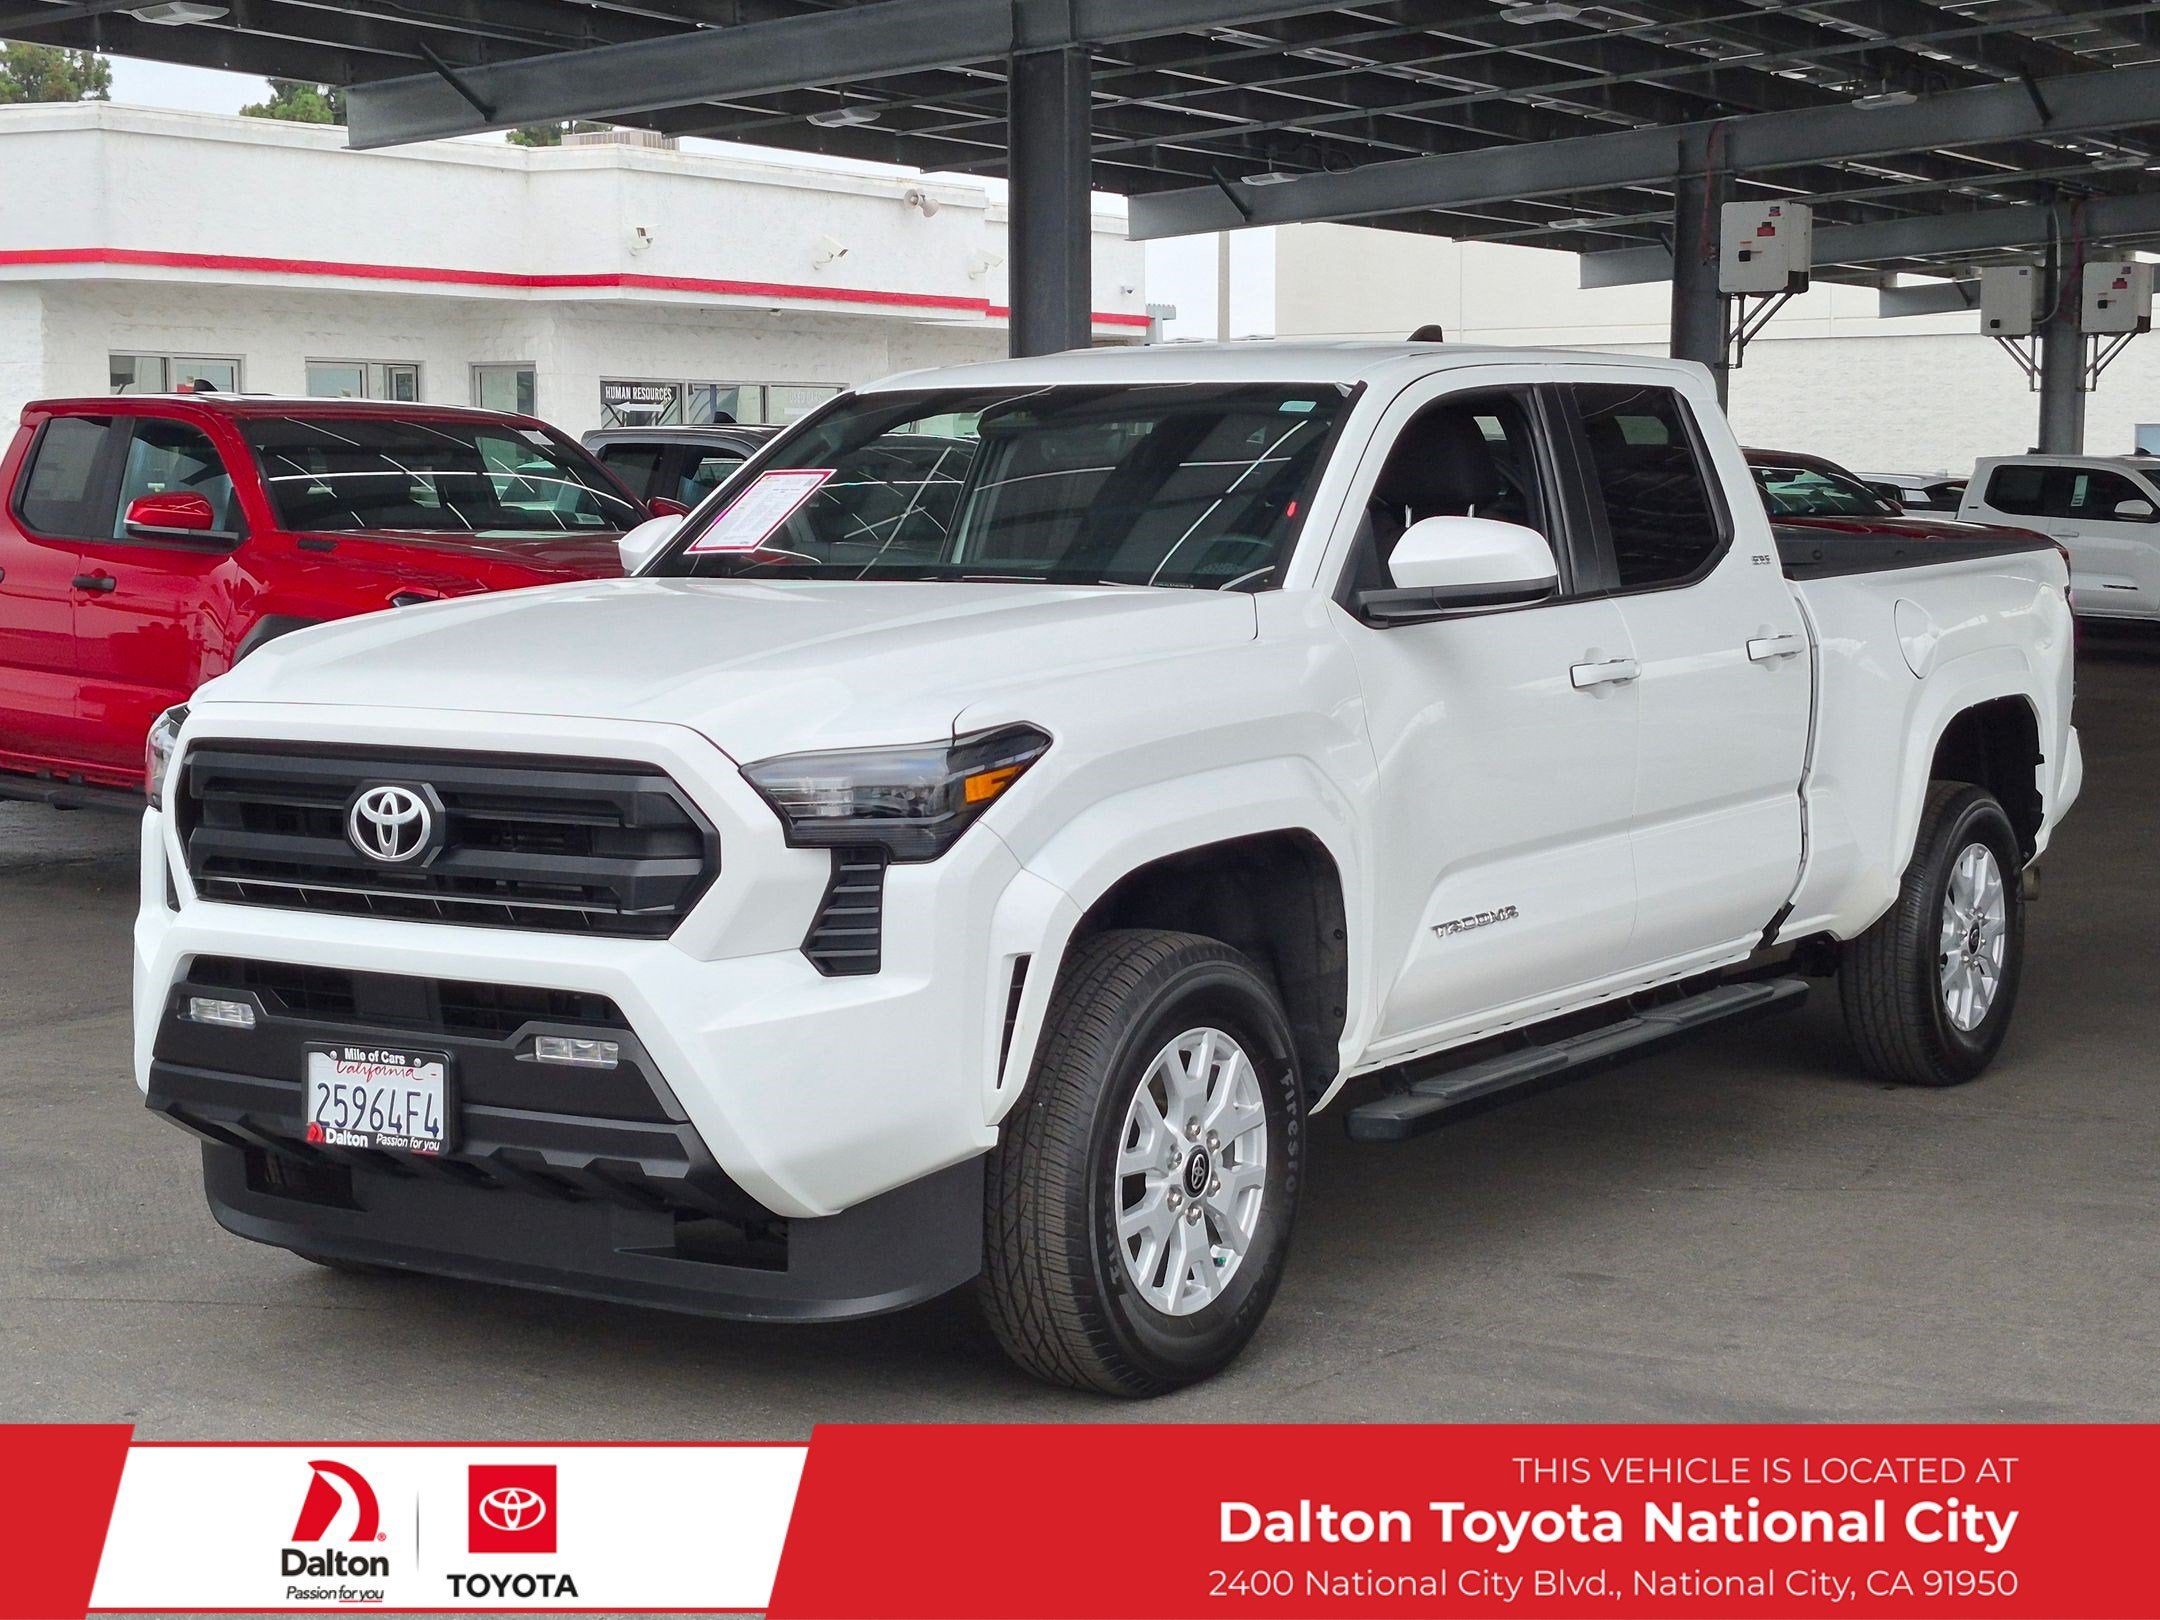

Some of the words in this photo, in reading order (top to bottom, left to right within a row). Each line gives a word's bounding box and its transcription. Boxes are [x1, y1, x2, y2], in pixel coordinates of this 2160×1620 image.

[605, 386, 631, 400] HUMAN
[632, 387, 672, 401] RESOURCES
[344, 1047, 366, 1060] Mile
[368, 1050, 380, 1062] of
[380, 1053, 406, 1065] Cars
[336, 1060, 423, 1083] California
[315, 1082, 440, 1138] 25964F4
[326, 1128, 369, 1148] Dalton
[376, 1133, 408, 1147] Passion
[409, 1136, 424, 1148] for
[423, 1141, 440, 1151] you
